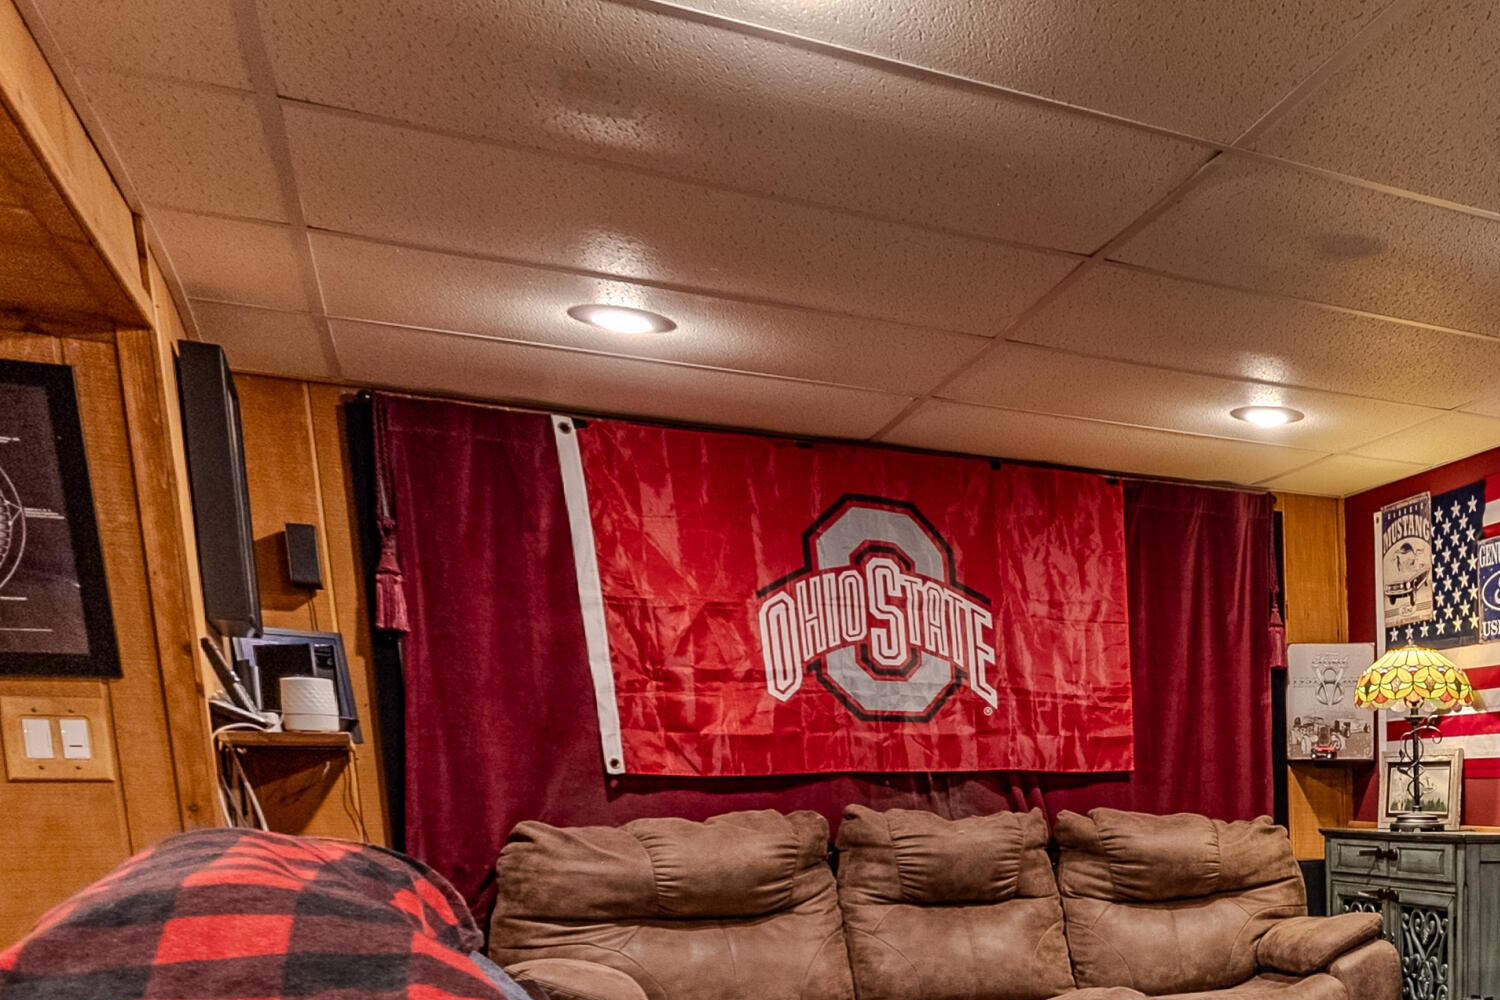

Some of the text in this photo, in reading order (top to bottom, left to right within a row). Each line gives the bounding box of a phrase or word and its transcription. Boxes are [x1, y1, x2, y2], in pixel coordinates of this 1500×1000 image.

[1383, 514, 1431, 554] MUSTANG
[758, 557, 998, 710] OHIO STATE
